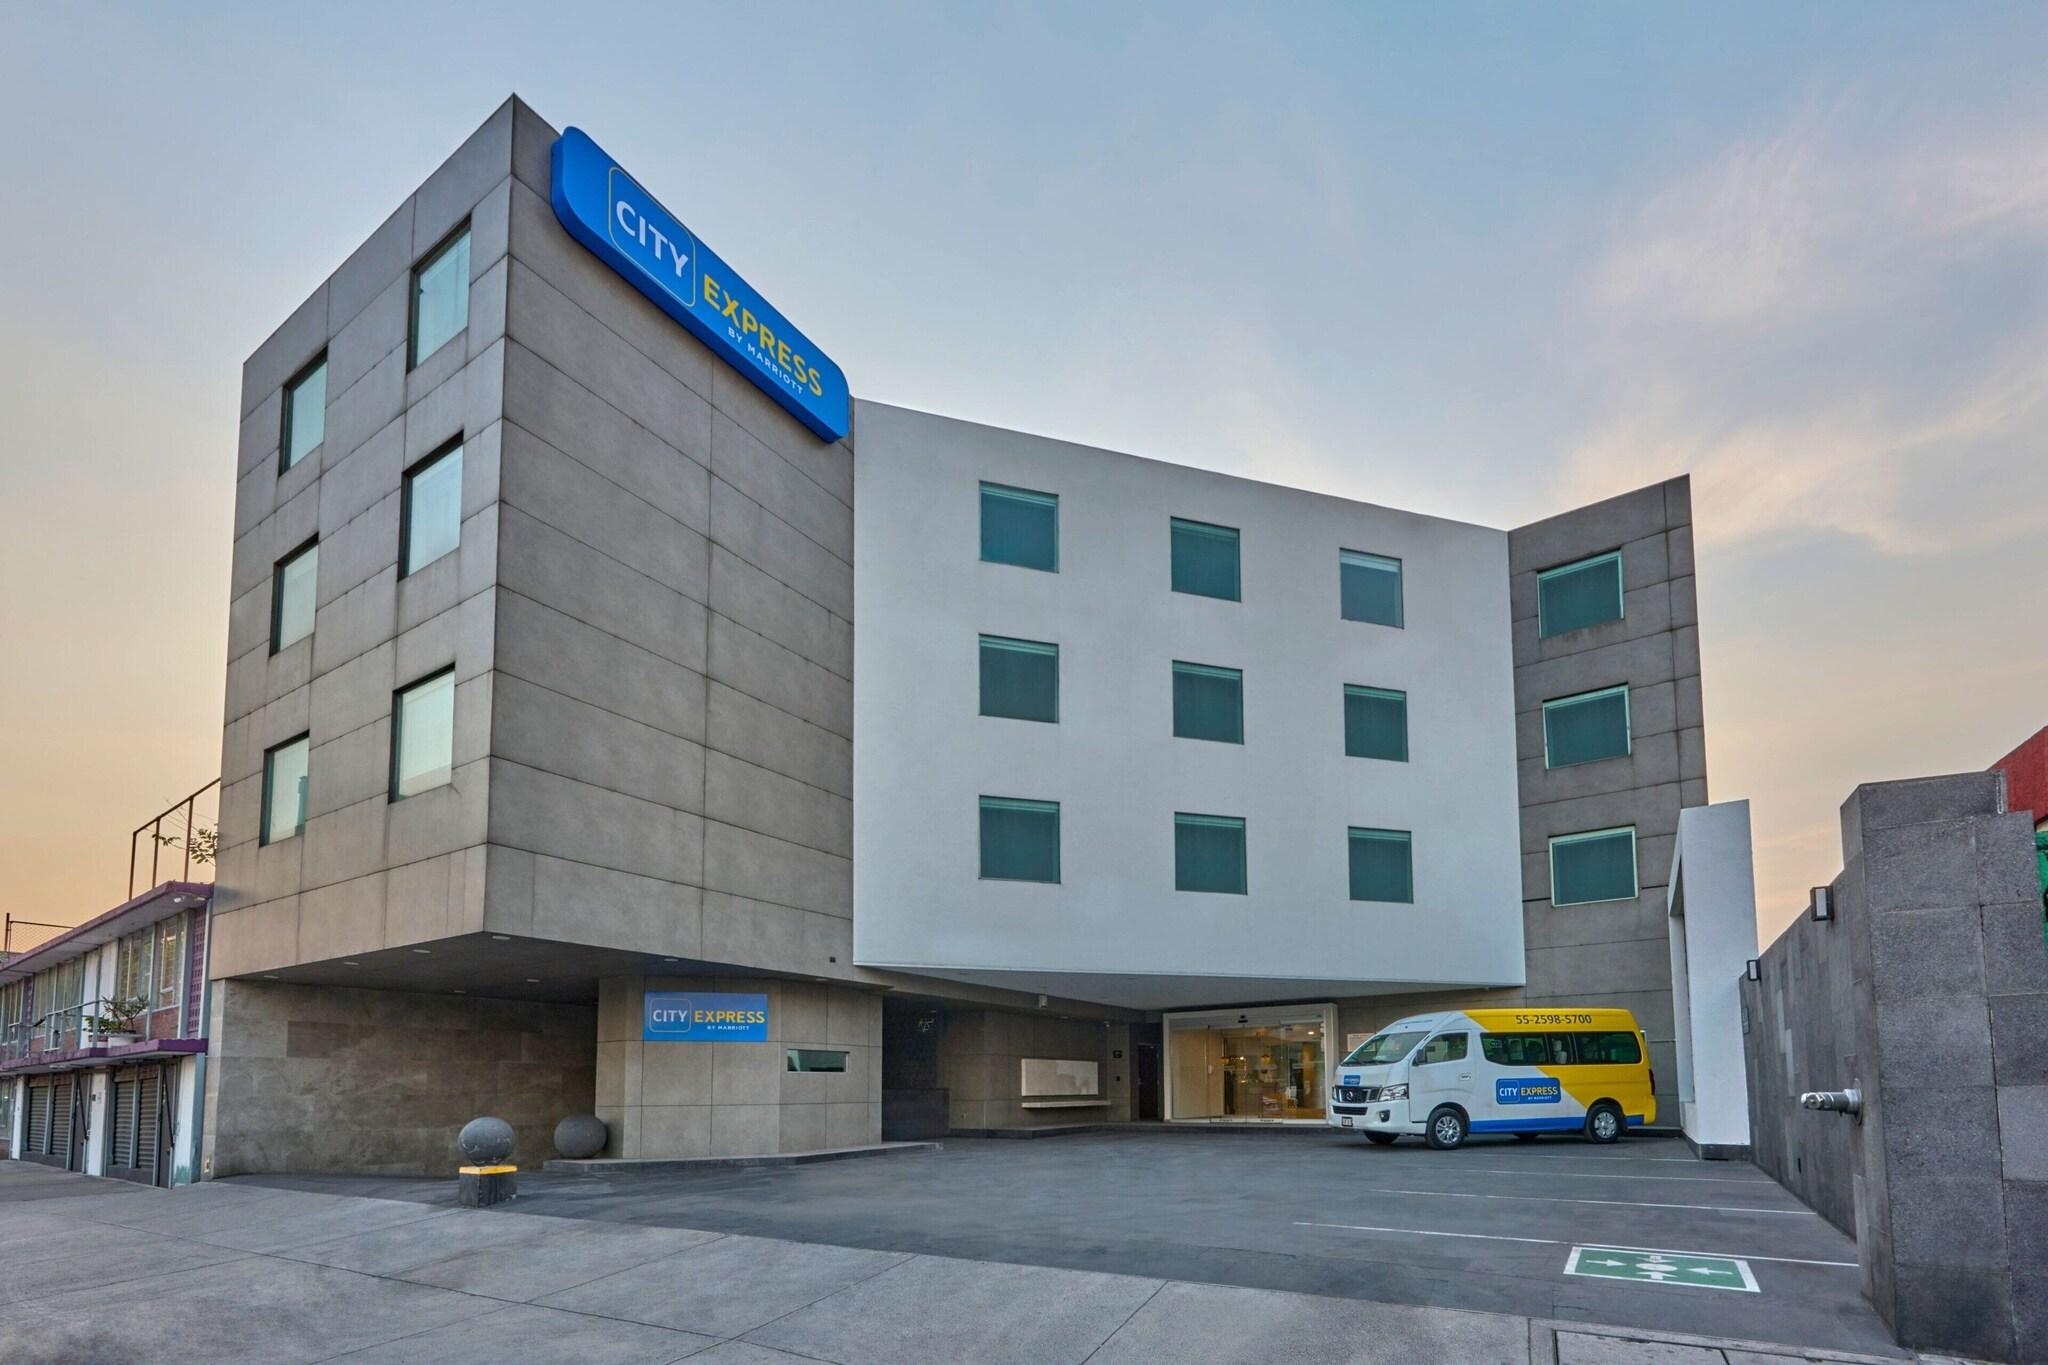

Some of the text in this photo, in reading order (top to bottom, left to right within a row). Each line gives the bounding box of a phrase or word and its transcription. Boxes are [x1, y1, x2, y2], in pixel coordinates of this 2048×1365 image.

[616, 200, 823, 397] CITY EXPRESS
[728, 326, 804, 395] BY MARRIOTT
[652, 1009, 766, 1024] CITY EXPRESS
[1515, 1014, 1593, 1025] 55-2598-5700
[1499, 1086, 1559, 1097] CITY EXPRESS
